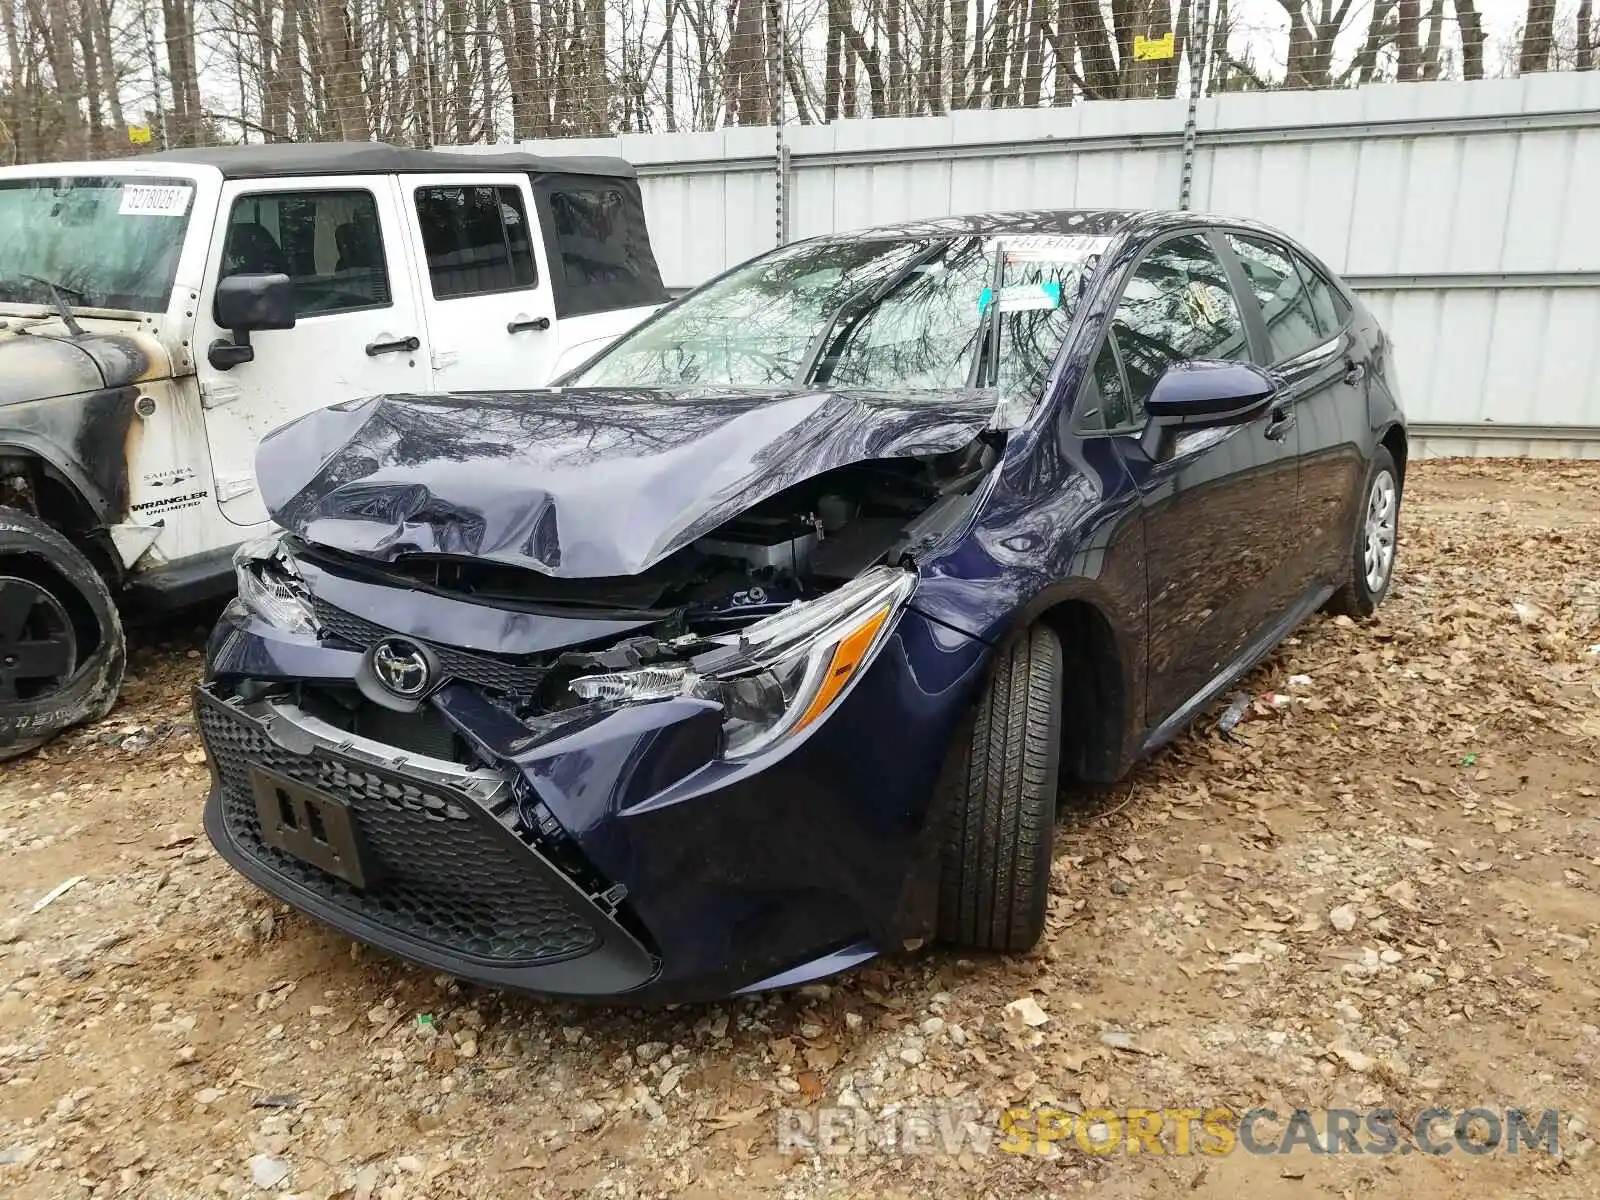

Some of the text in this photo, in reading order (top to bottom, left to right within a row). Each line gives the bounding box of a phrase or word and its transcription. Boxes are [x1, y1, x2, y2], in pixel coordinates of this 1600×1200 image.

[143, 467, 193, 480] SAHARA
[131, 491, 208, 511] WRANGLER
[146, 501, 201, 516] UNLIMITED
